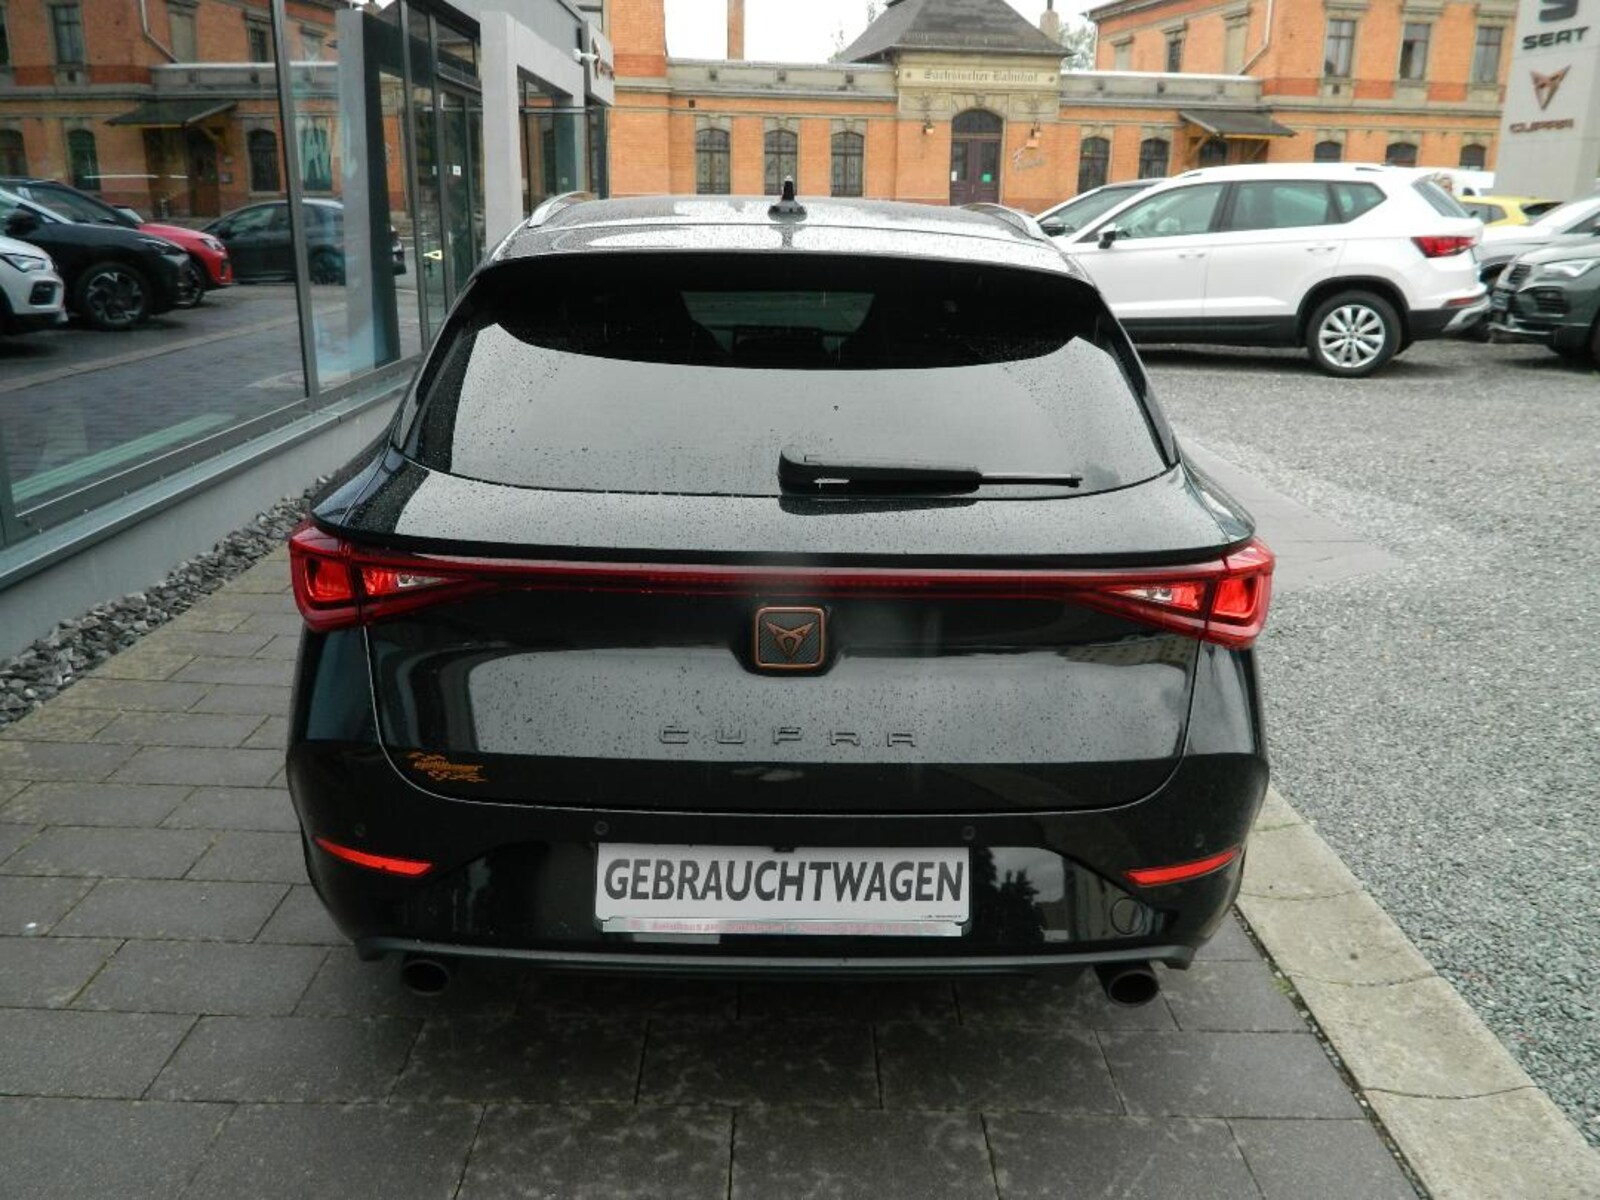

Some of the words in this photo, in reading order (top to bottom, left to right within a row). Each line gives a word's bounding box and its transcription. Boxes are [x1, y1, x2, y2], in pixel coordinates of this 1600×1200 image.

[1522, 26, 1590, 50] SEAT
[659, 726, 917, 748] CUPRA
[603, 858, 965, 903] GEBRAUCHTWAGEN
